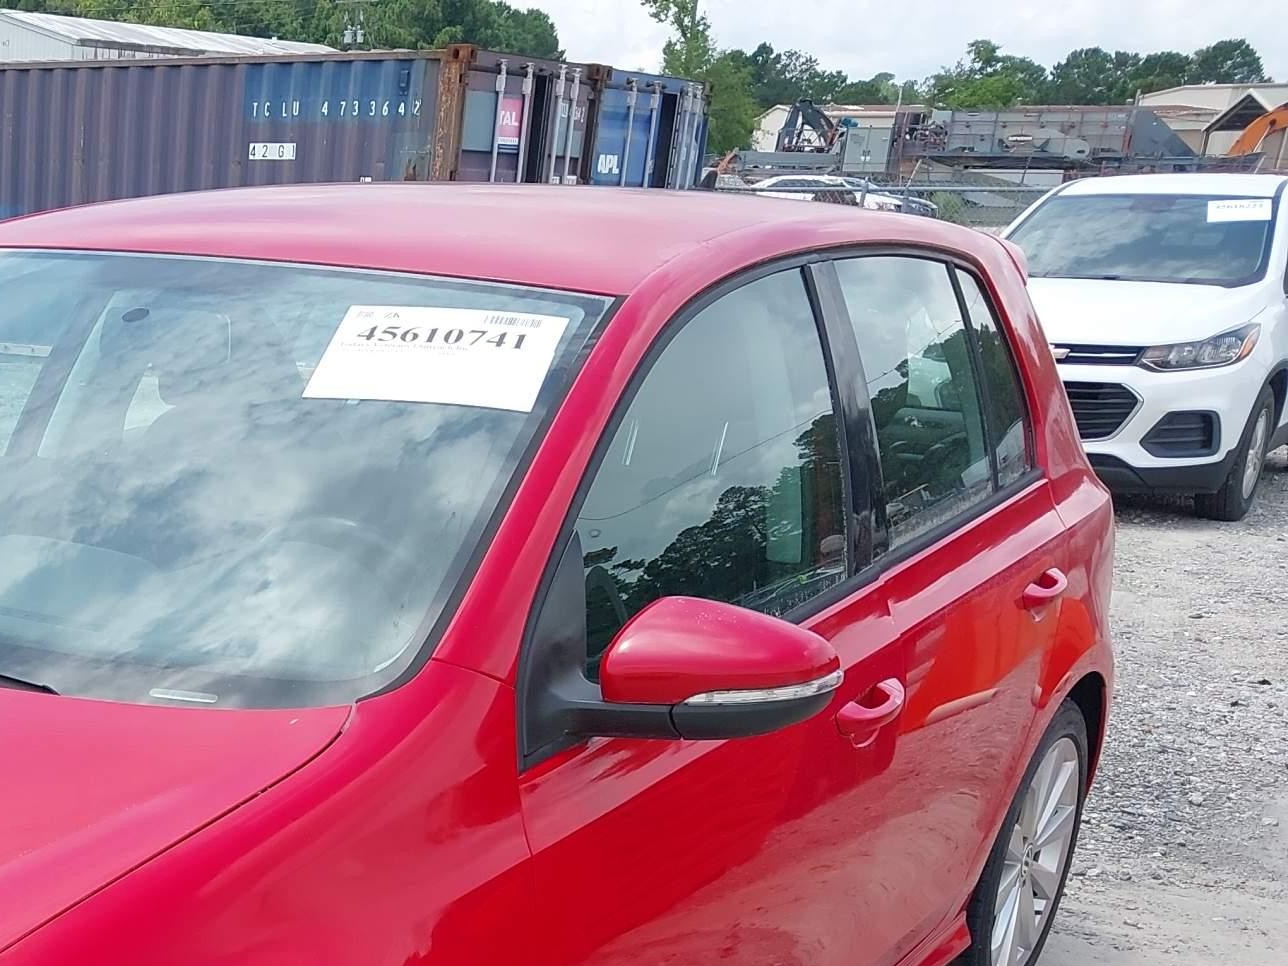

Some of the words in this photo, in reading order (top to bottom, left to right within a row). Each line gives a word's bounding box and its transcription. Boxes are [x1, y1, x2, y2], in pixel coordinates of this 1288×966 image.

[498, 109, 520, 127] TAL
[597, 153, 620, 175] APL
[357, 325, 527, 350] 45610741
